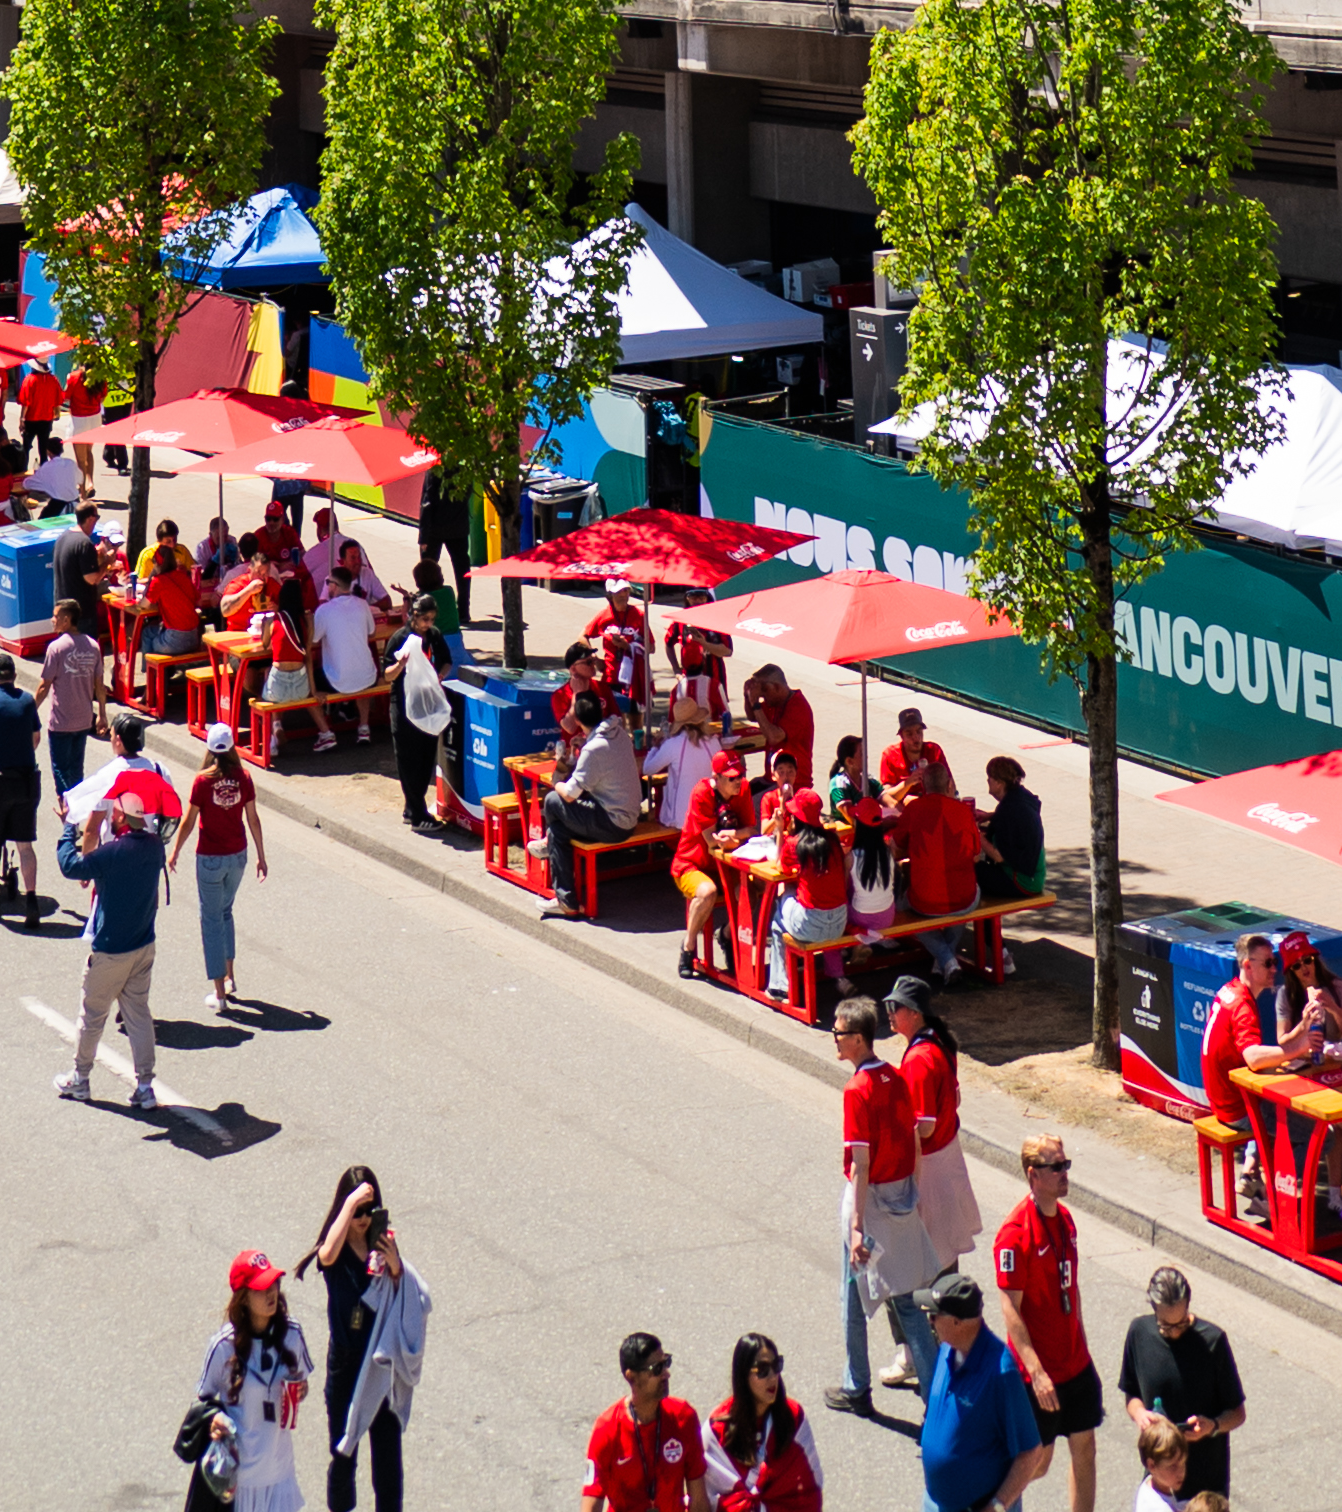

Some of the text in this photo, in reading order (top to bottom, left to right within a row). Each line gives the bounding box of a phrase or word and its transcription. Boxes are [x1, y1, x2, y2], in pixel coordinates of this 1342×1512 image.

[133, 429, 186, 443] Coca-Cola
[255, 460, 315, 474] Coca-Cola
[726, 542, 765, 562] Coca-Cola
[735, 617, 793, 639] Coca-Cola
[905, 620, 969, 642] Coca-Cola
[1246, 802, 1320, 835] Coca-Cola
[1132, 966, 1158, 982] LANDFILL
[1165, 1100, 1195, 1120] Coca-Cola
